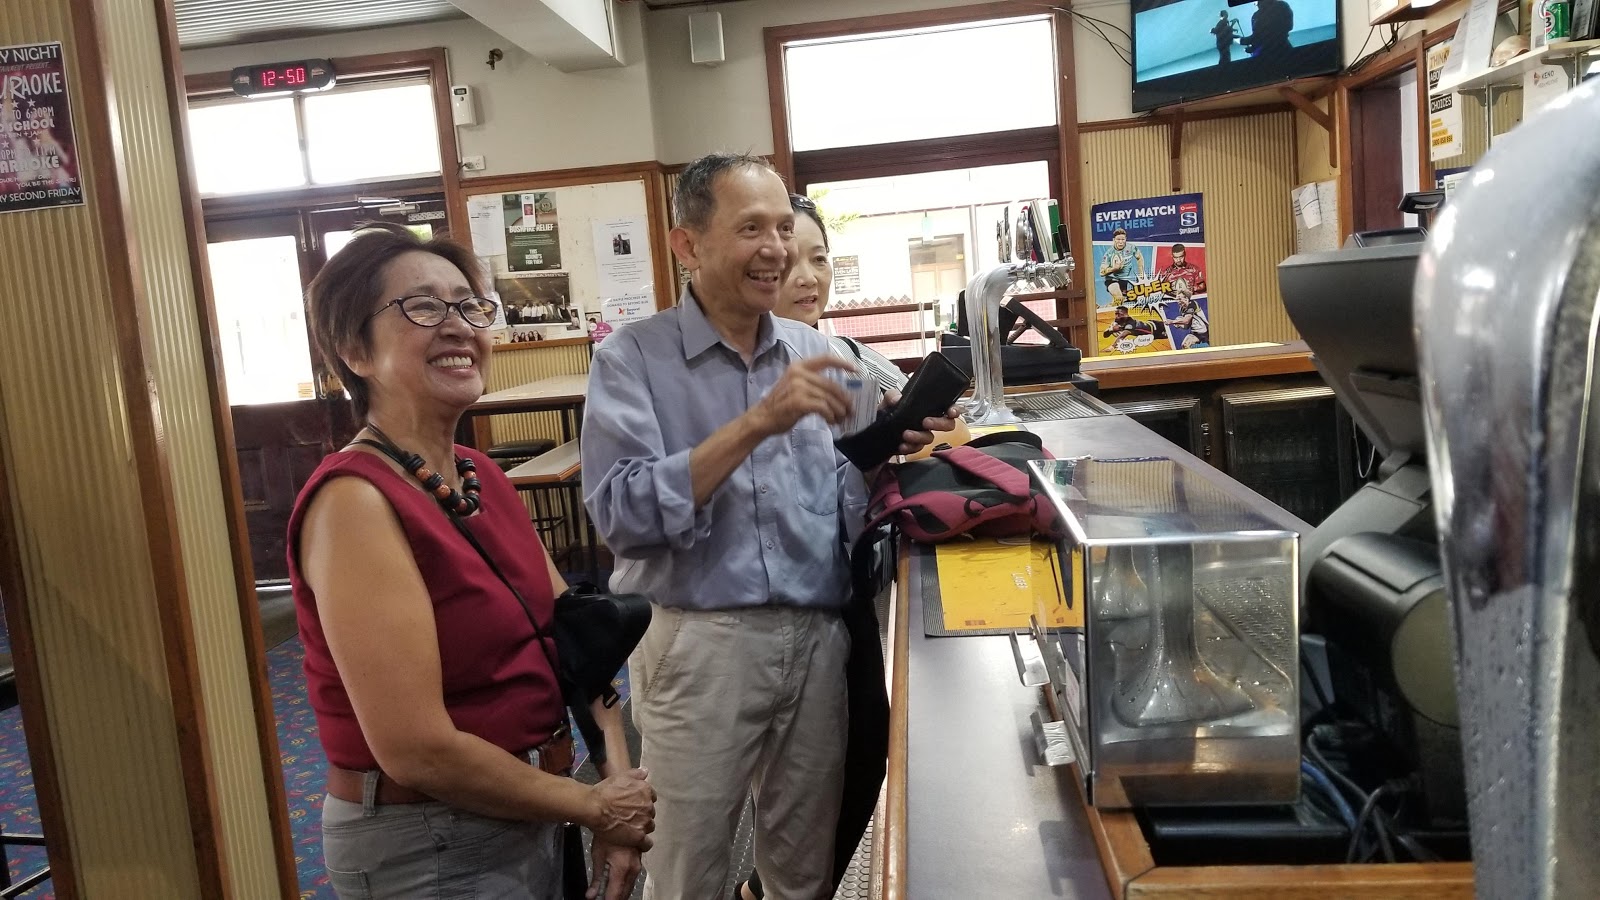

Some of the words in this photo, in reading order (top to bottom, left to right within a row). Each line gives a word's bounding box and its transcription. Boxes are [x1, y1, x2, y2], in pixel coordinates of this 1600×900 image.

[13, 45, 58, 62] NIGHT
[1541, 70, 1555, 79] KENO
[1431, 95, 1452, 112] CHOICES
[26, 106, 55, 119] 6:30PM
[9, 118, 55, 132] SCHOOL
[9, 190, 46, 202] SECOND
[48, 186, 81, 198] FRIDAY
[1095, 209, 1133, 222] EVERY
[1135, 205, 1176, 218] MATCH
[536, 223, 554, 232] RELIEF
[1096, 220, 1121, 232] LIVE
[1124, 217, 1155, 230] HERE
[1126, 280, 1172, 301] SUPER
